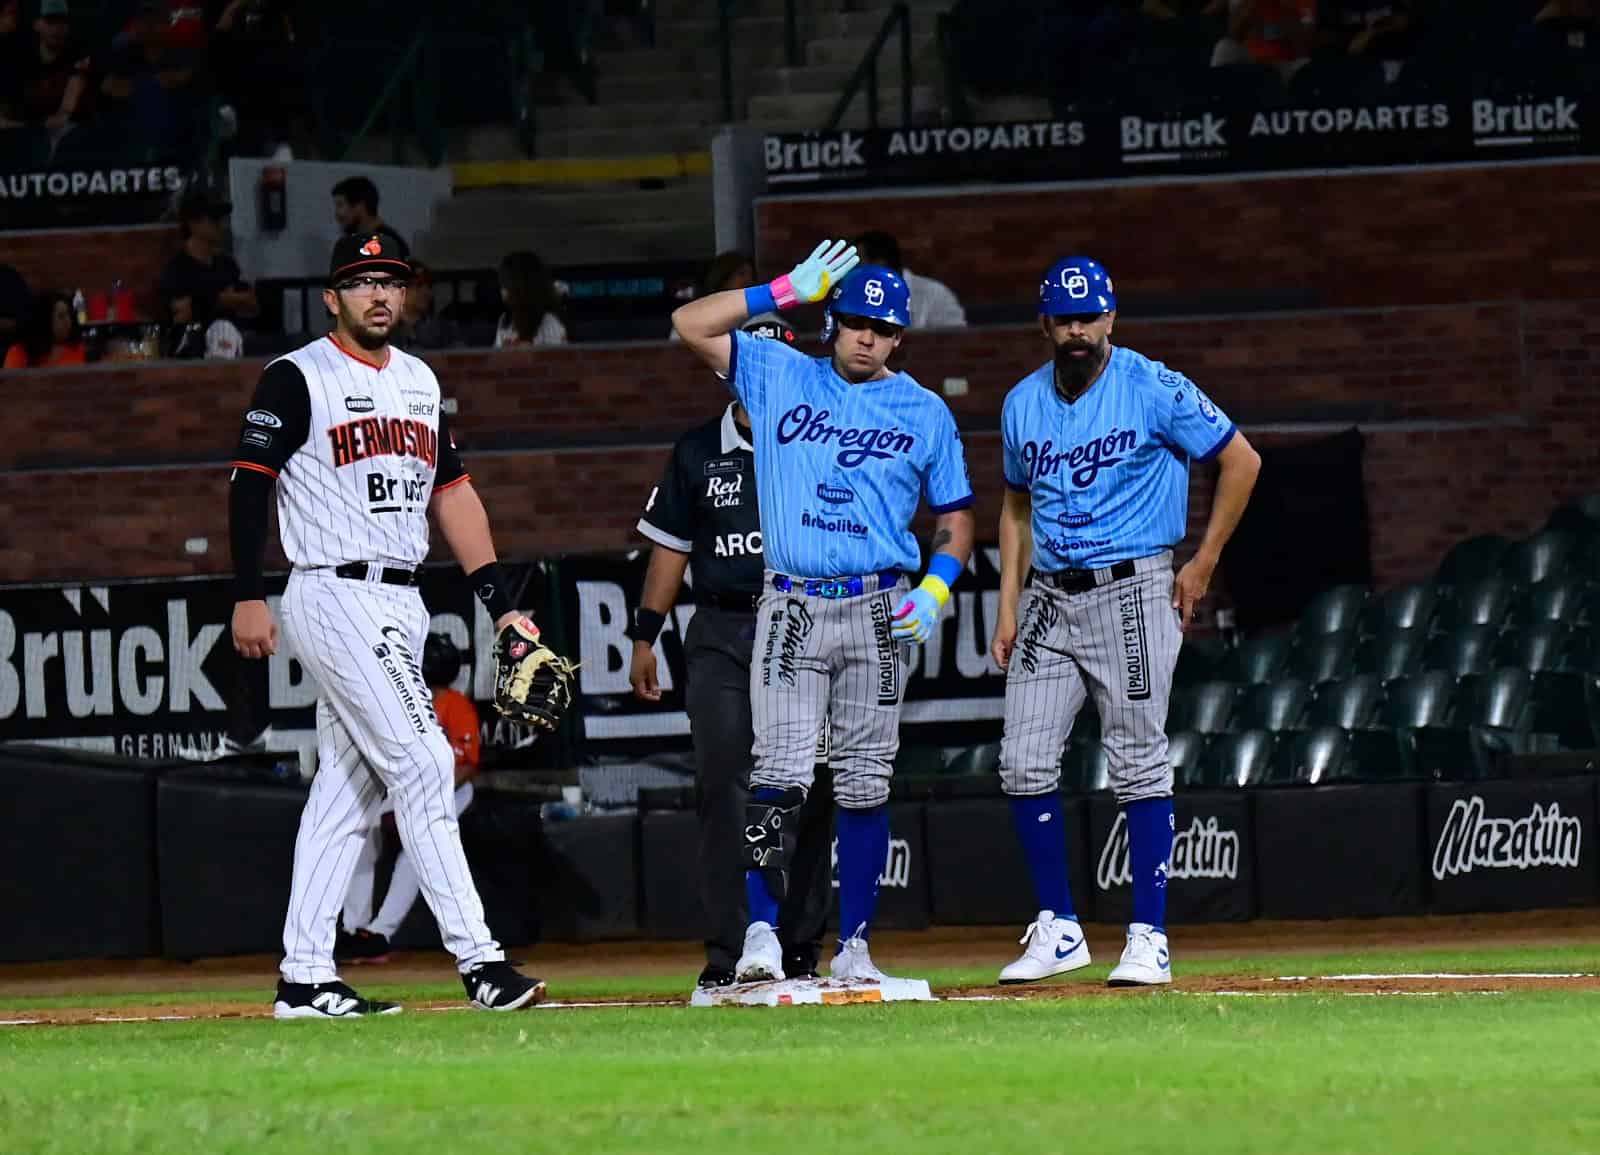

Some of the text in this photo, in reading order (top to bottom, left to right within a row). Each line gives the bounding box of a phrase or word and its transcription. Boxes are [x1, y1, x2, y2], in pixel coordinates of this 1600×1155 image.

[888, 121, 1086, 156] AUTOPARTES
[1250, 103, 1449, 136] AUTOPARTES
[777, 404, 915, 468] Obregón
[706, 474, 743, 497] Red
[714, 494, 740, 508] Cola
[762, 622, 781, 687] caliene.mx
[870, 602, 893, 694] PAQUETEXPRESS
[1119, 593, 1142, 689] PAQUETEXPRESS
[383, 657, 427, 735] caliente.mx
[1097, 811, 1239, 890] Matún
